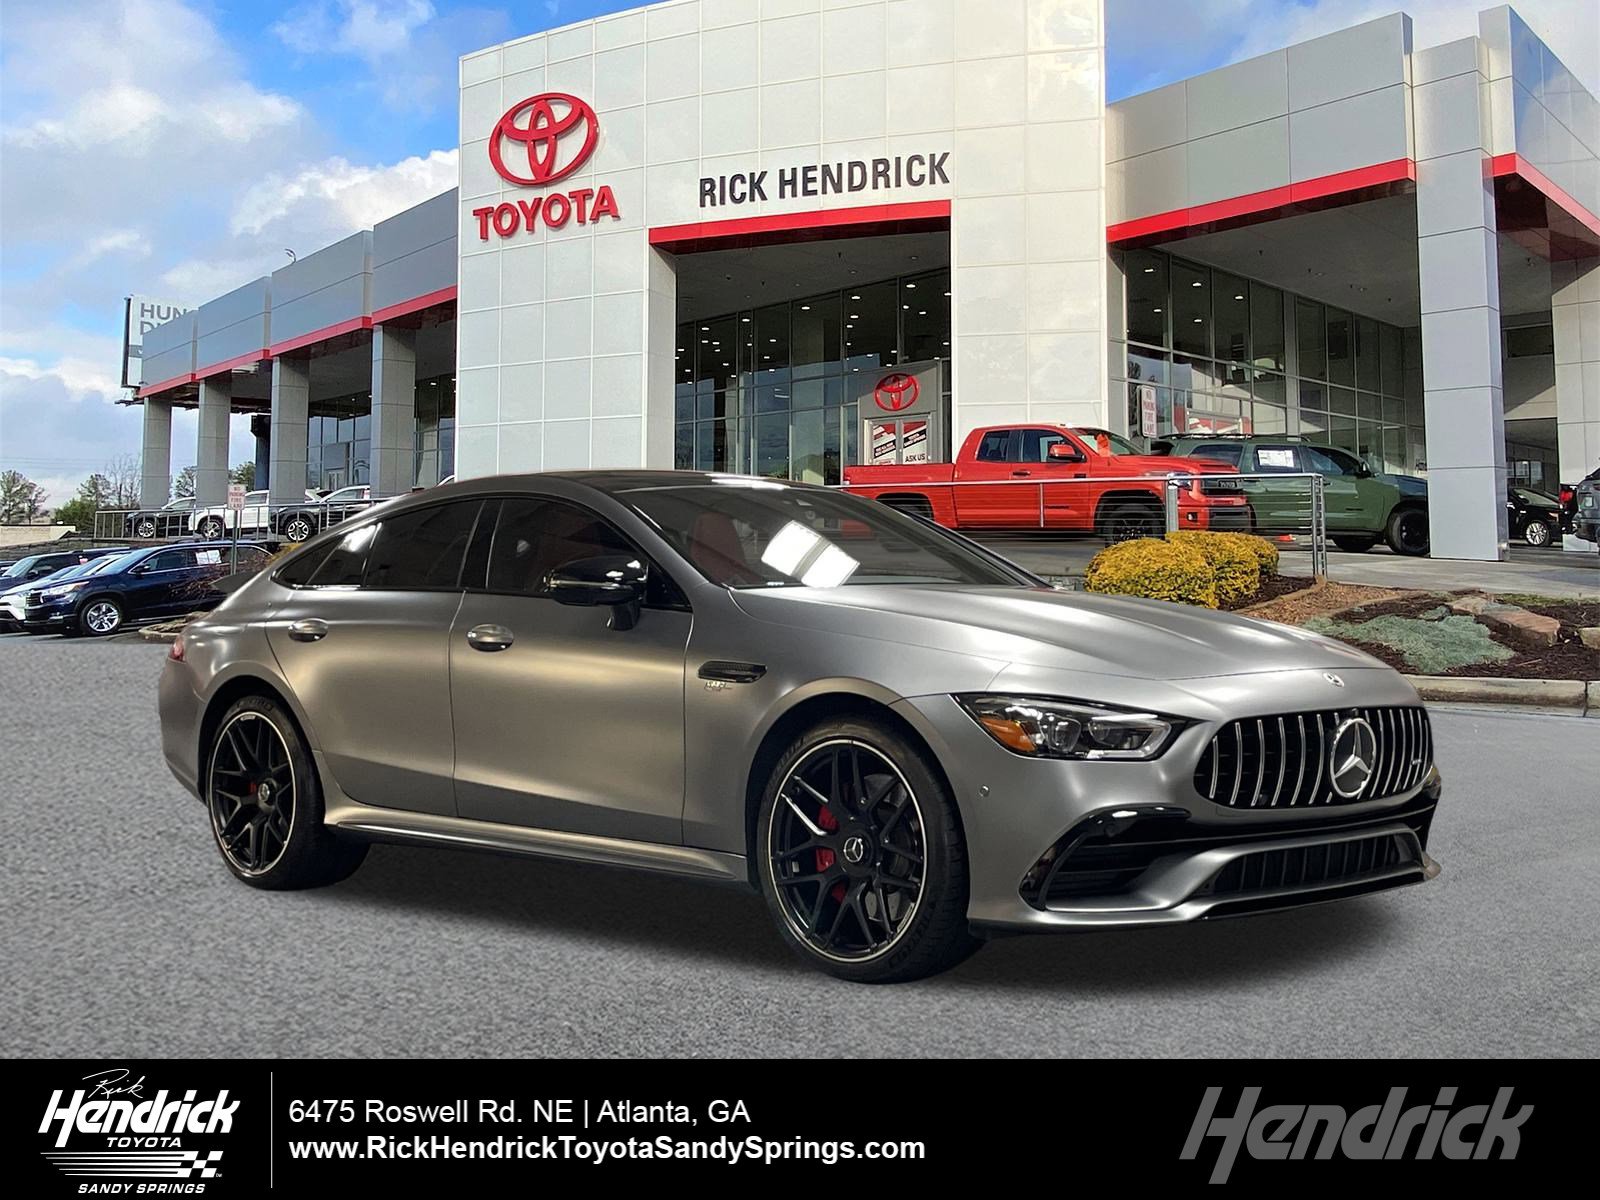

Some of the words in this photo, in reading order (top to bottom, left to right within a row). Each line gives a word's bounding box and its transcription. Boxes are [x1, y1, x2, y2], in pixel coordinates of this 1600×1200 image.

[699, 170, 768, 208] RICK
[778, 152, 951, 200] HENDRICK
[472, 185, 620, 241] TOYOTA
[917, 453, 927, 461] US
